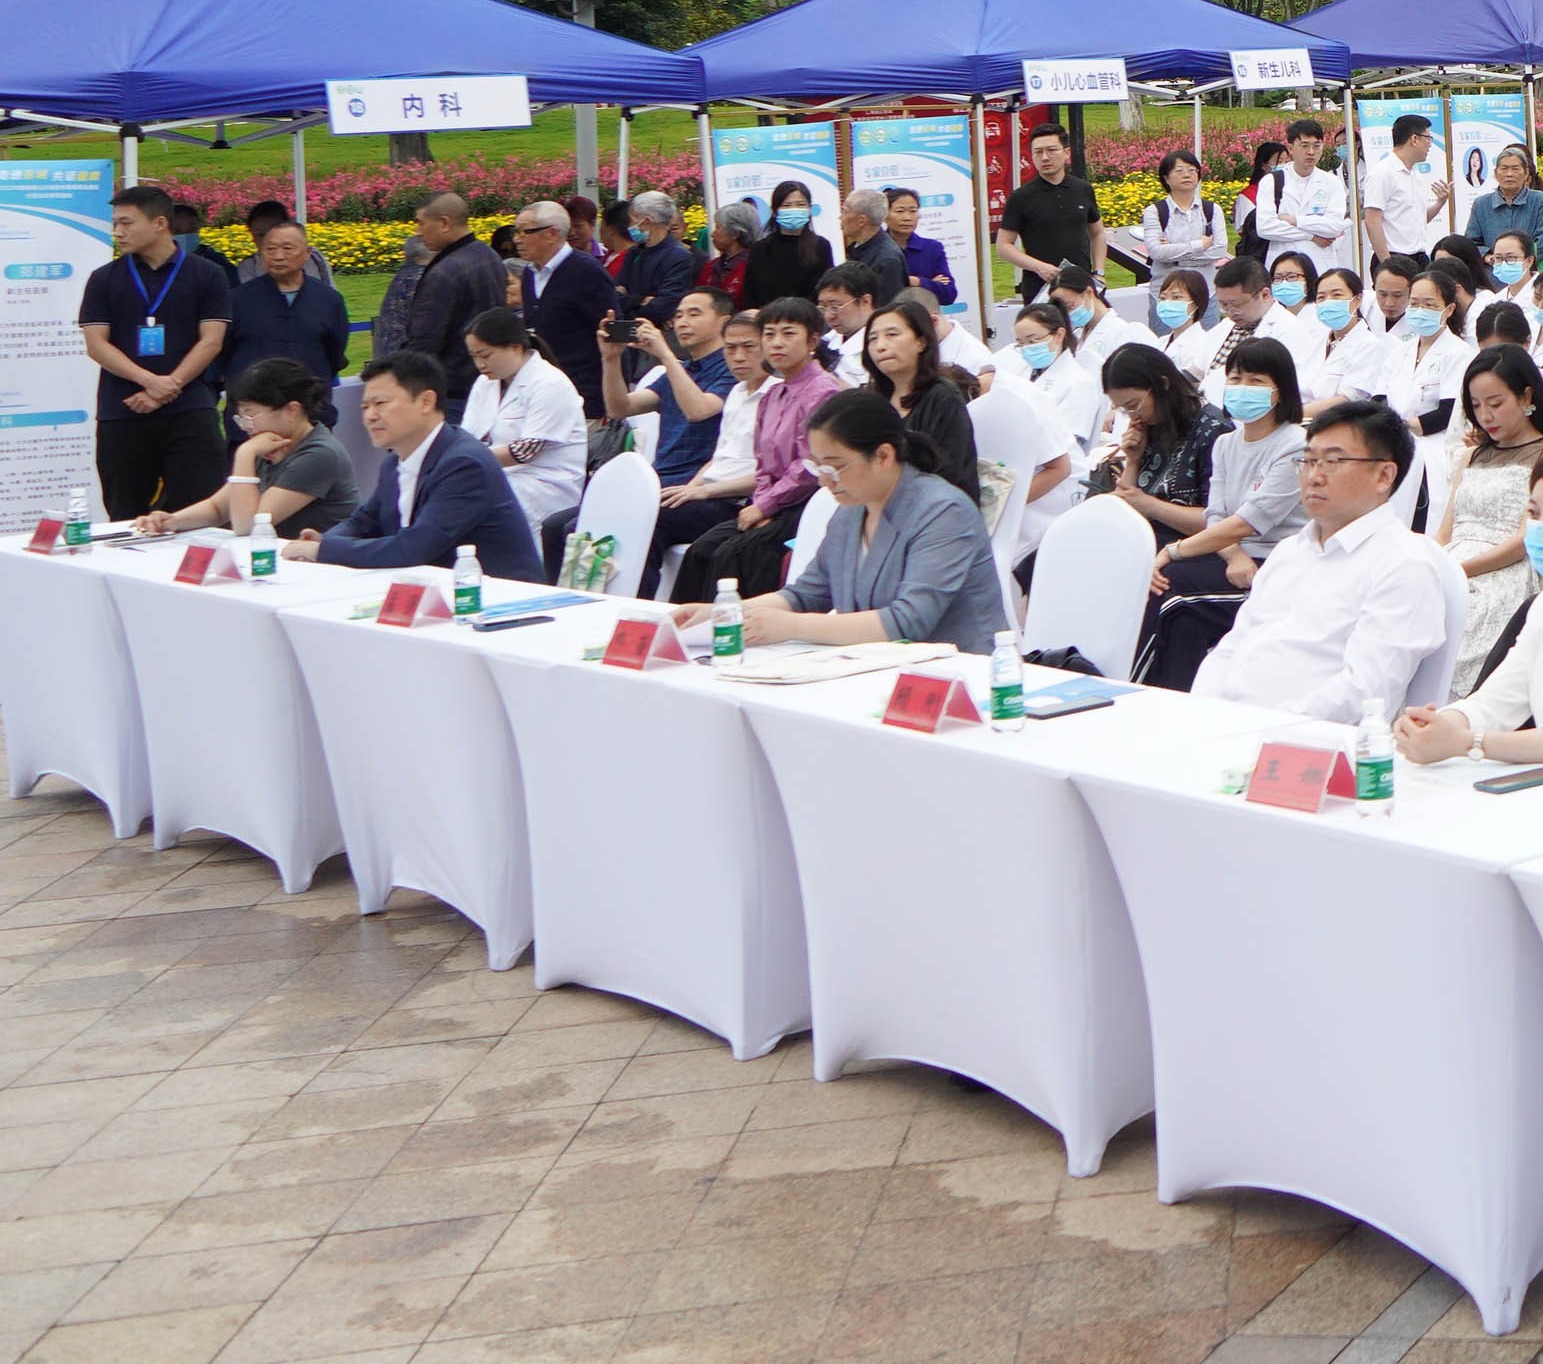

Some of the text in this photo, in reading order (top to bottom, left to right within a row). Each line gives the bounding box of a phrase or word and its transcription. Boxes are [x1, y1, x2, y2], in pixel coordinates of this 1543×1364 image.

[1257, 60, 1301, 78] 新生儿科
[1050, 72, 1122, 92] 小儿心血管科
[402, 91, 463, 119] 内科
